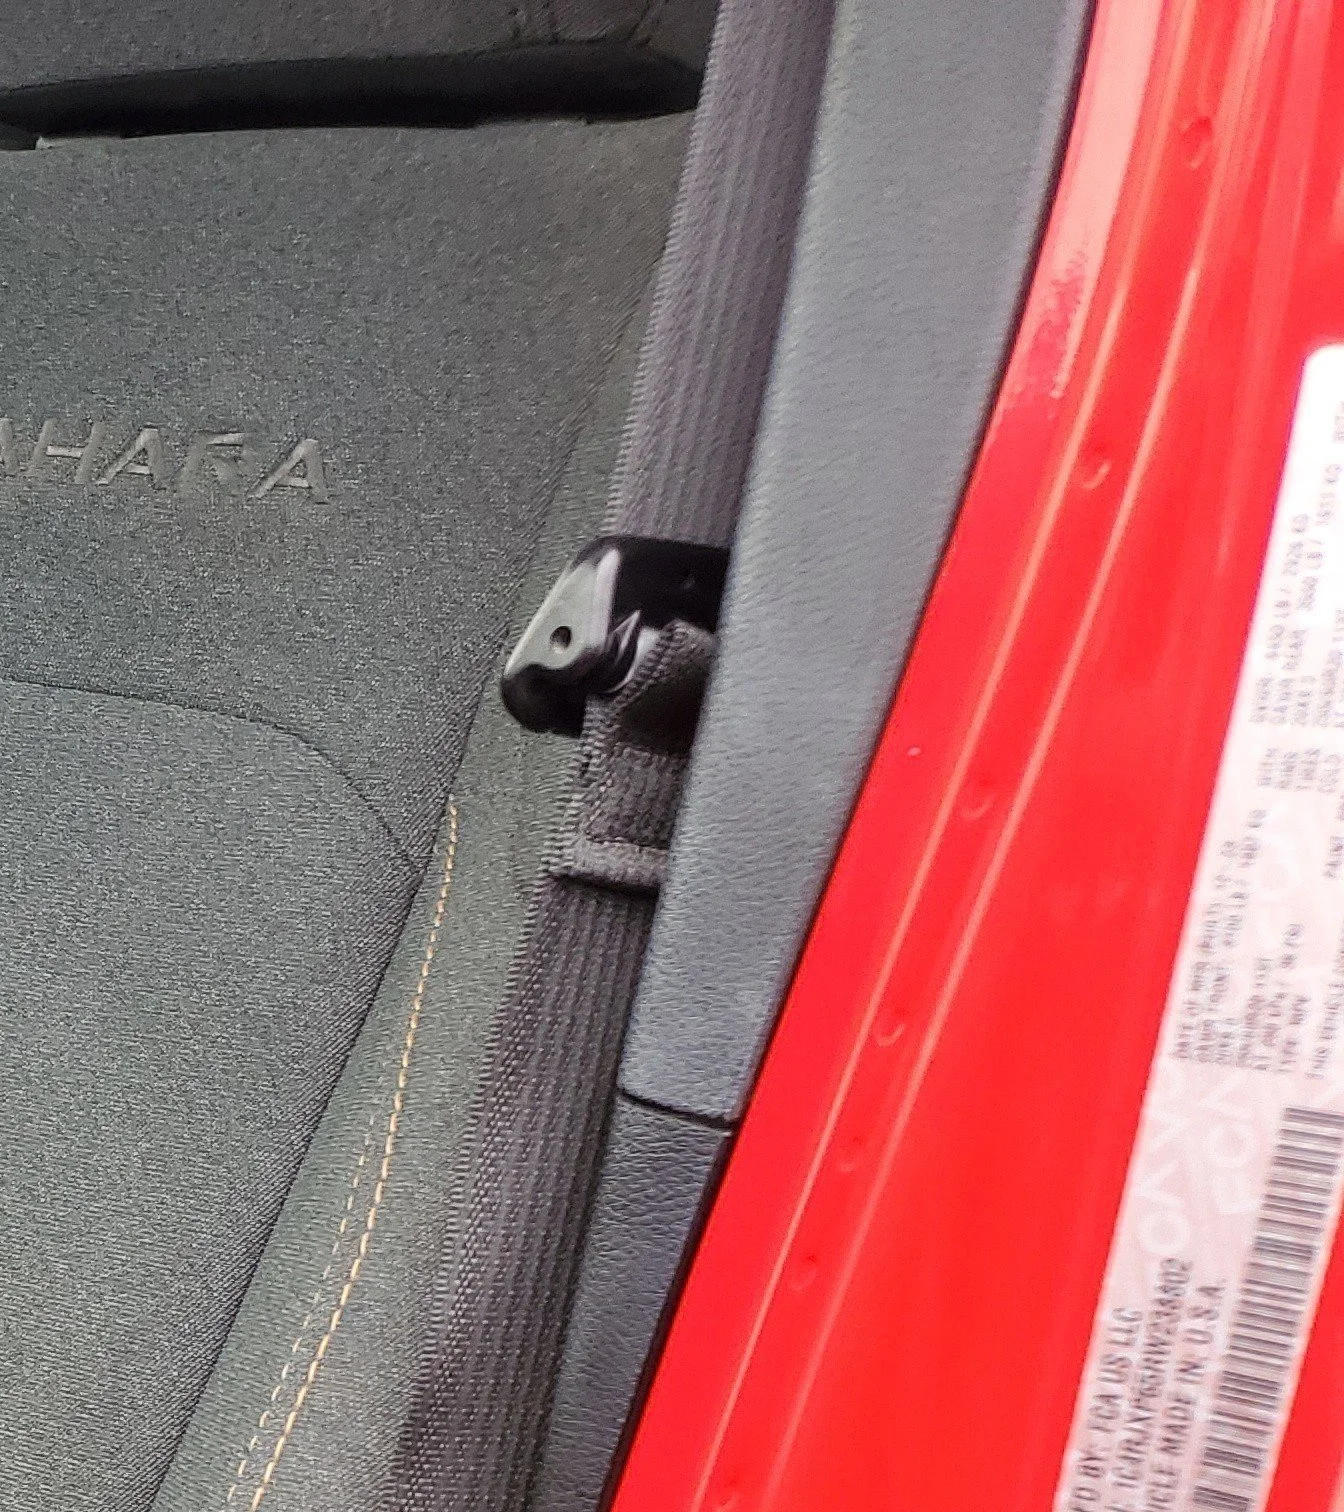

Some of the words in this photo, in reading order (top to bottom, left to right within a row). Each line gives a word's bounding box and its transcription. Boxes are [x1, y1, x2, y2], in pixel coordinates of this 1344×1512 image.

[1107, 1307, 1144, 1348] LLC
[1098, 1352, 1131, 1385] US
[1175, 1358, 1205, 1386] IN
[1088, 1391, 1123, 1435] FCA
[1159, 1390, 1196, 1456] MADE
